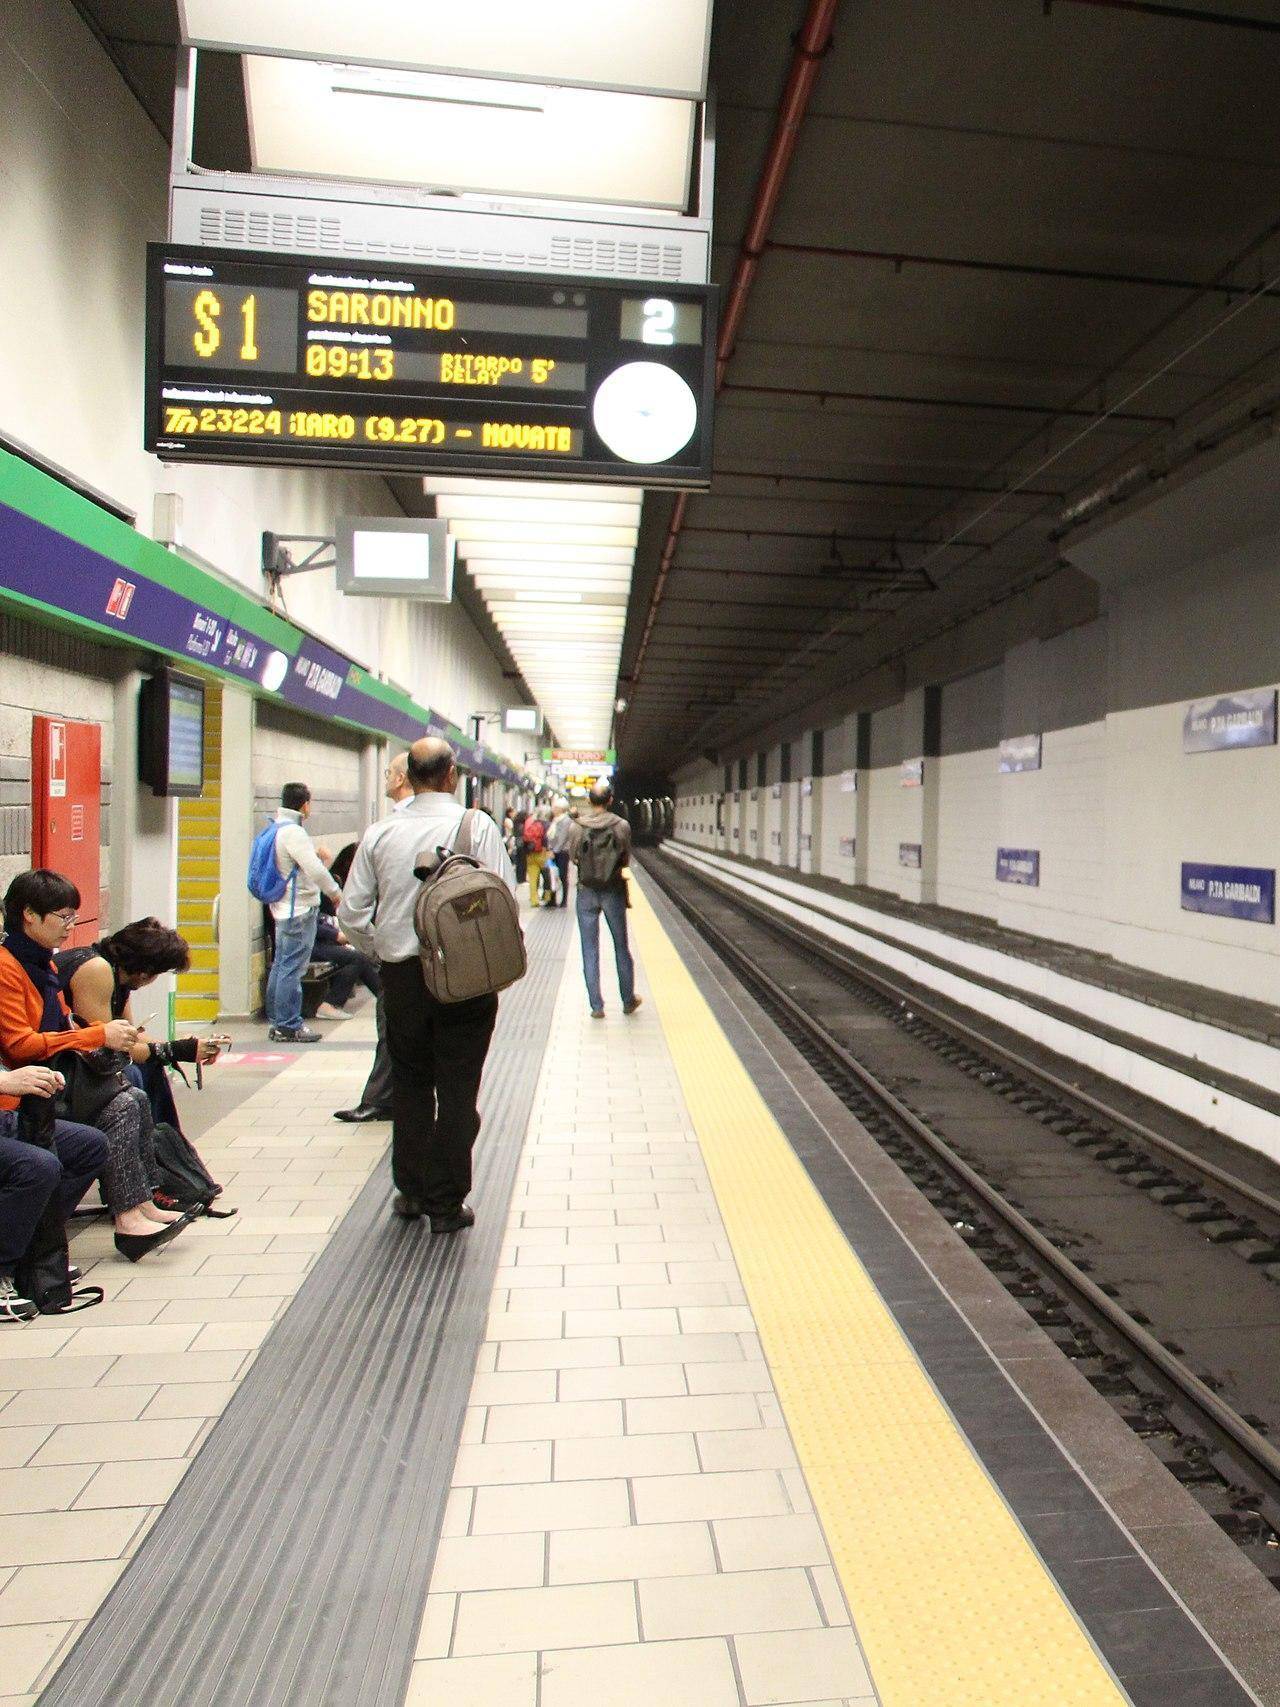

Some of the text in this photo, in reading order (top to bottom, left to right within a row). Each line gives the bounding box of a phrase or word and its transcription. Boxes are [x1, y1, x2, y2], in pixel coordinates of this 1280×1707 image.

[194, 289, 258, 360] S 1
[307, 289, 455, 331] SARONNO
[642, 297, 676, 346] 2
[306, 344, 394, 381] 09:13
[440, 352, 522, 374] RITARDO
[440, 367, 502, 386] DELAY
[200, 408, 281, 436] 23224
[365, 415, 446, 444] (9.27)
